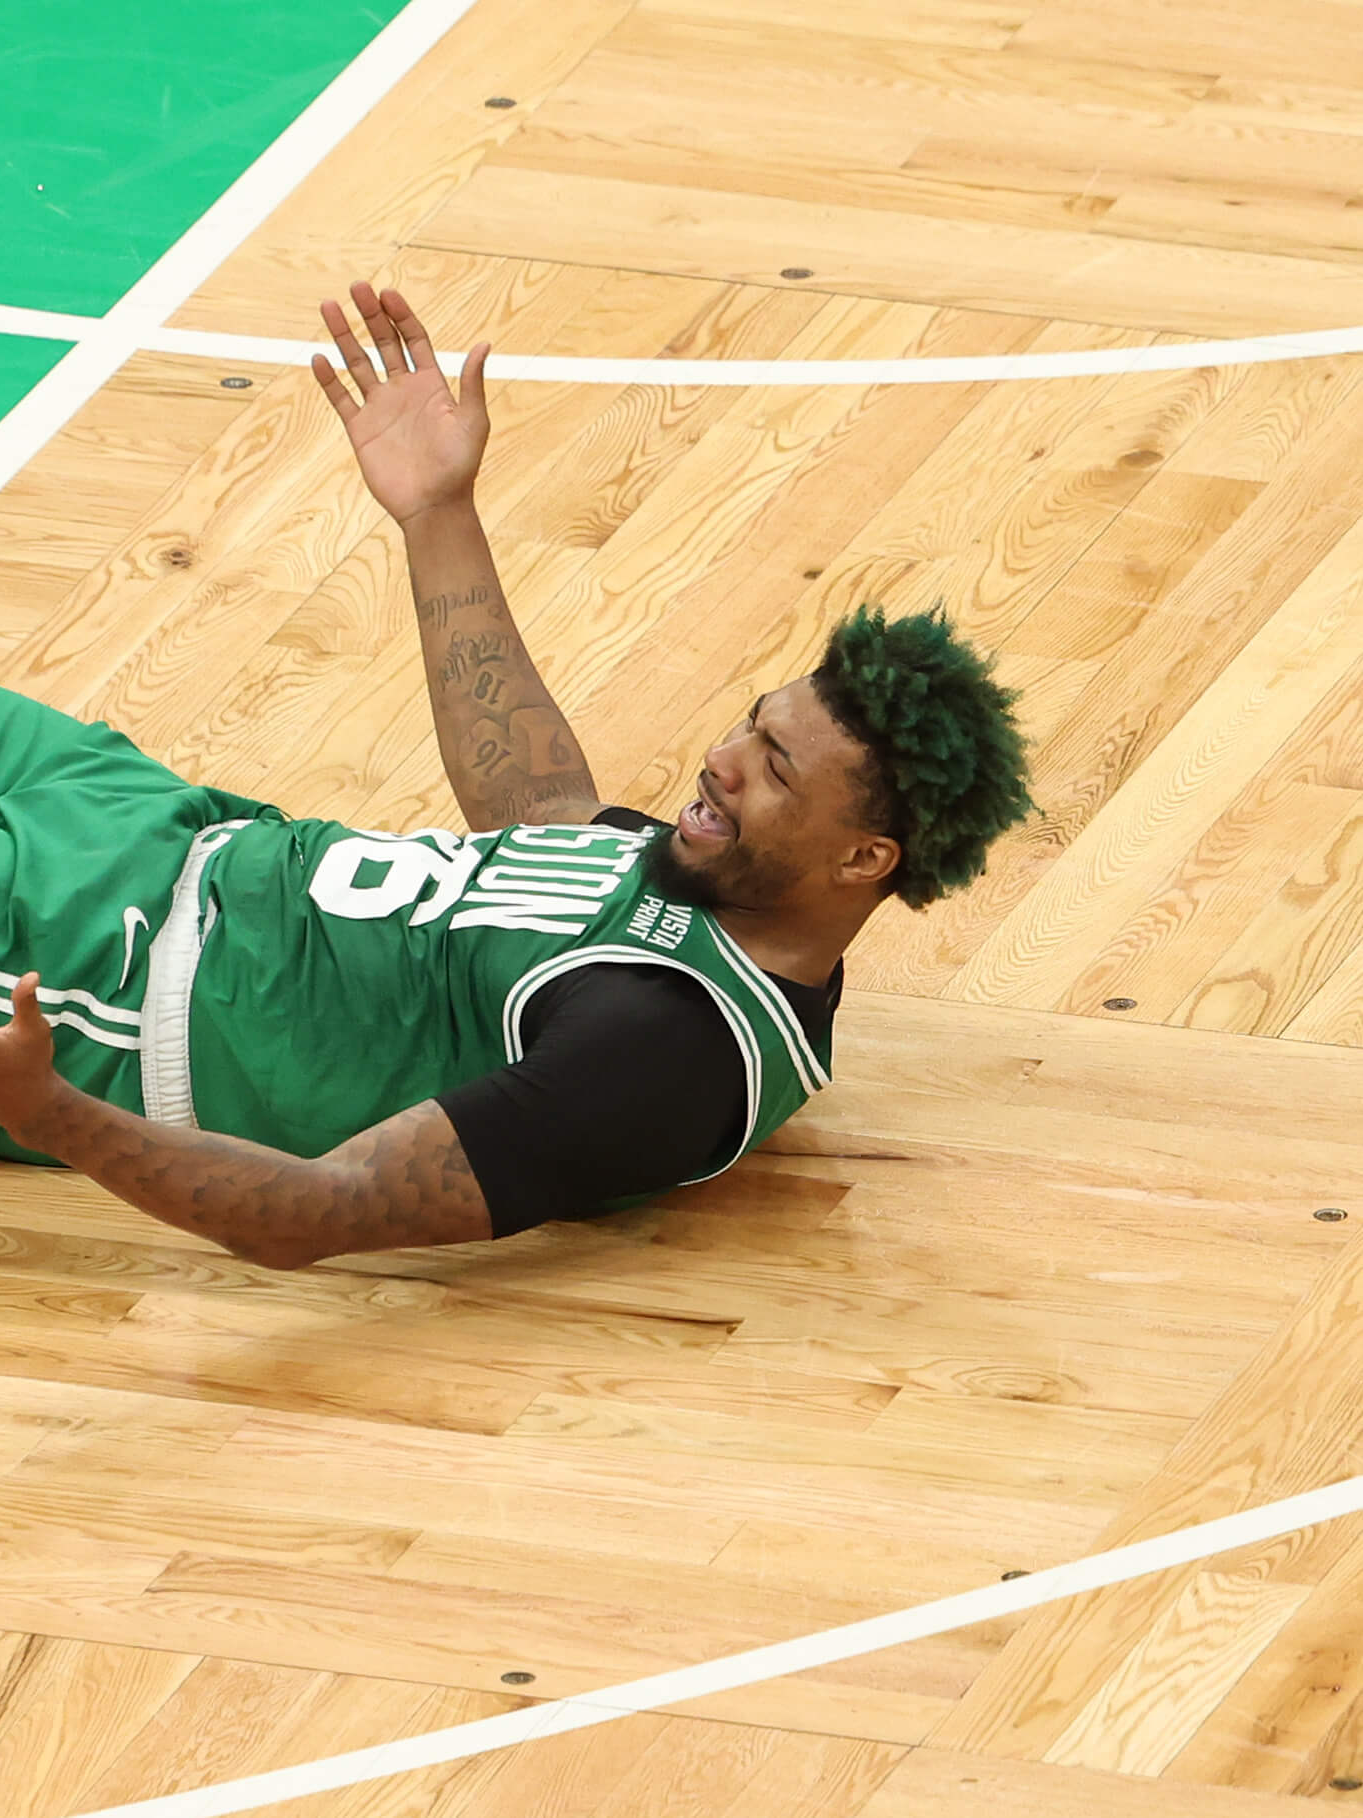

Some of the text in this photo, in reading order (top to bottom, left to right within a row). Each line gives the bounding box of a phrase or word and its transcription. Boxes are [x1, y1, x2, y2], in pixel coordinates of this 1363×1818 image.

[449, 823, 657, 936] STON
[626, 894, 665, 940] PRINT
[647, 904, 693, 950] VISTA
